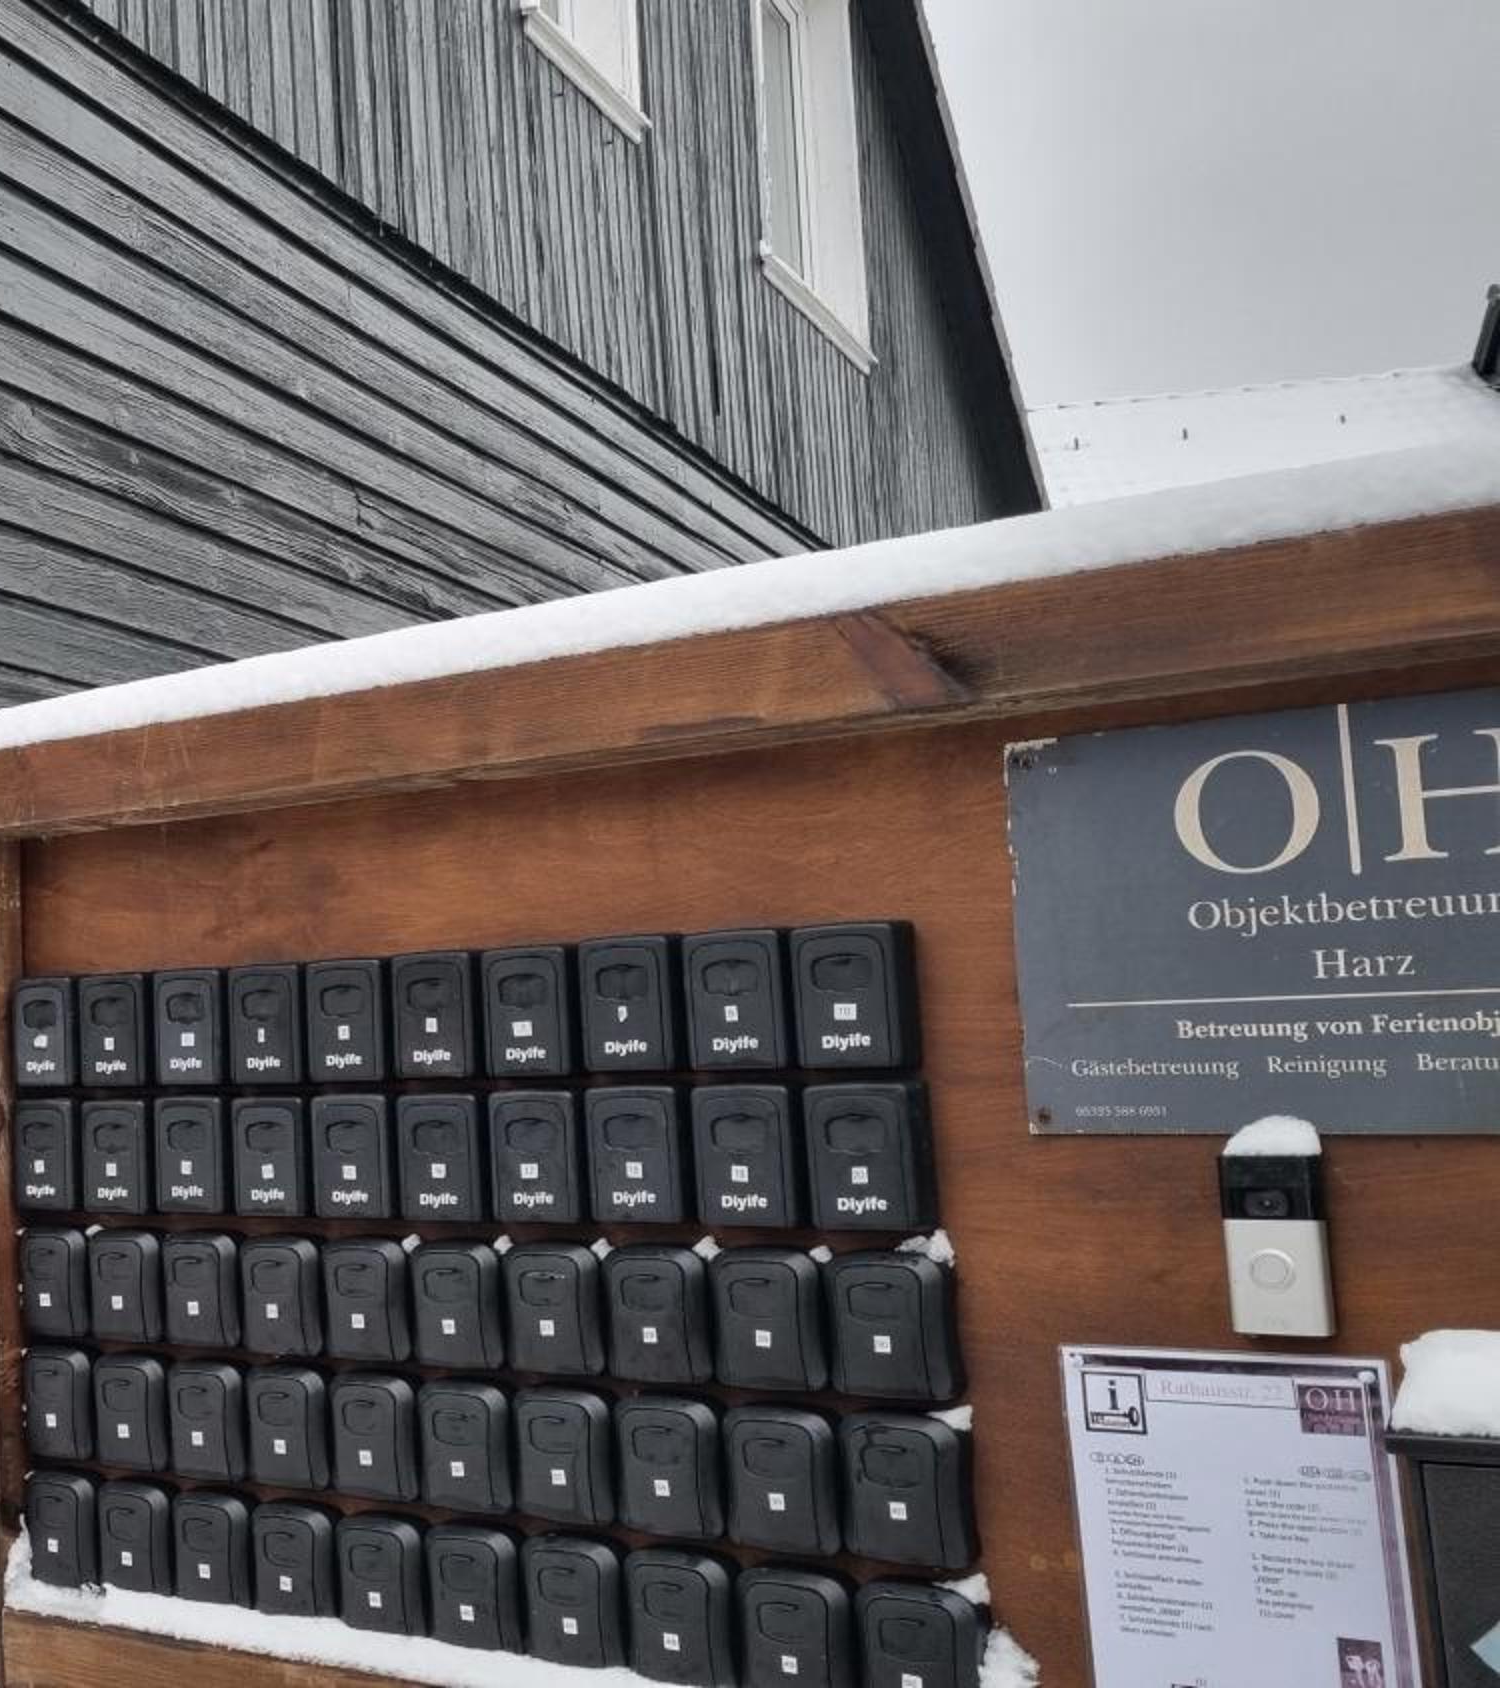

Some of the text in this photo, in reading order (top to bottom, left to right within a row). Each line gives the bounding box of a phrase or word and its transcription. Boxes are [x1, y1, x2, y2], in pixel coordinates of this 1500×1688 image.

[1313, 948, 1416, 979] Harz
[1176, 1019, 1308, 1042] Betreuung
[1315, 1018, 1363, 1035] von
[1071, 1058, 1239, 1080] Gästebetreuung
[1267, 1055, 1387, 1078] Reinigung
